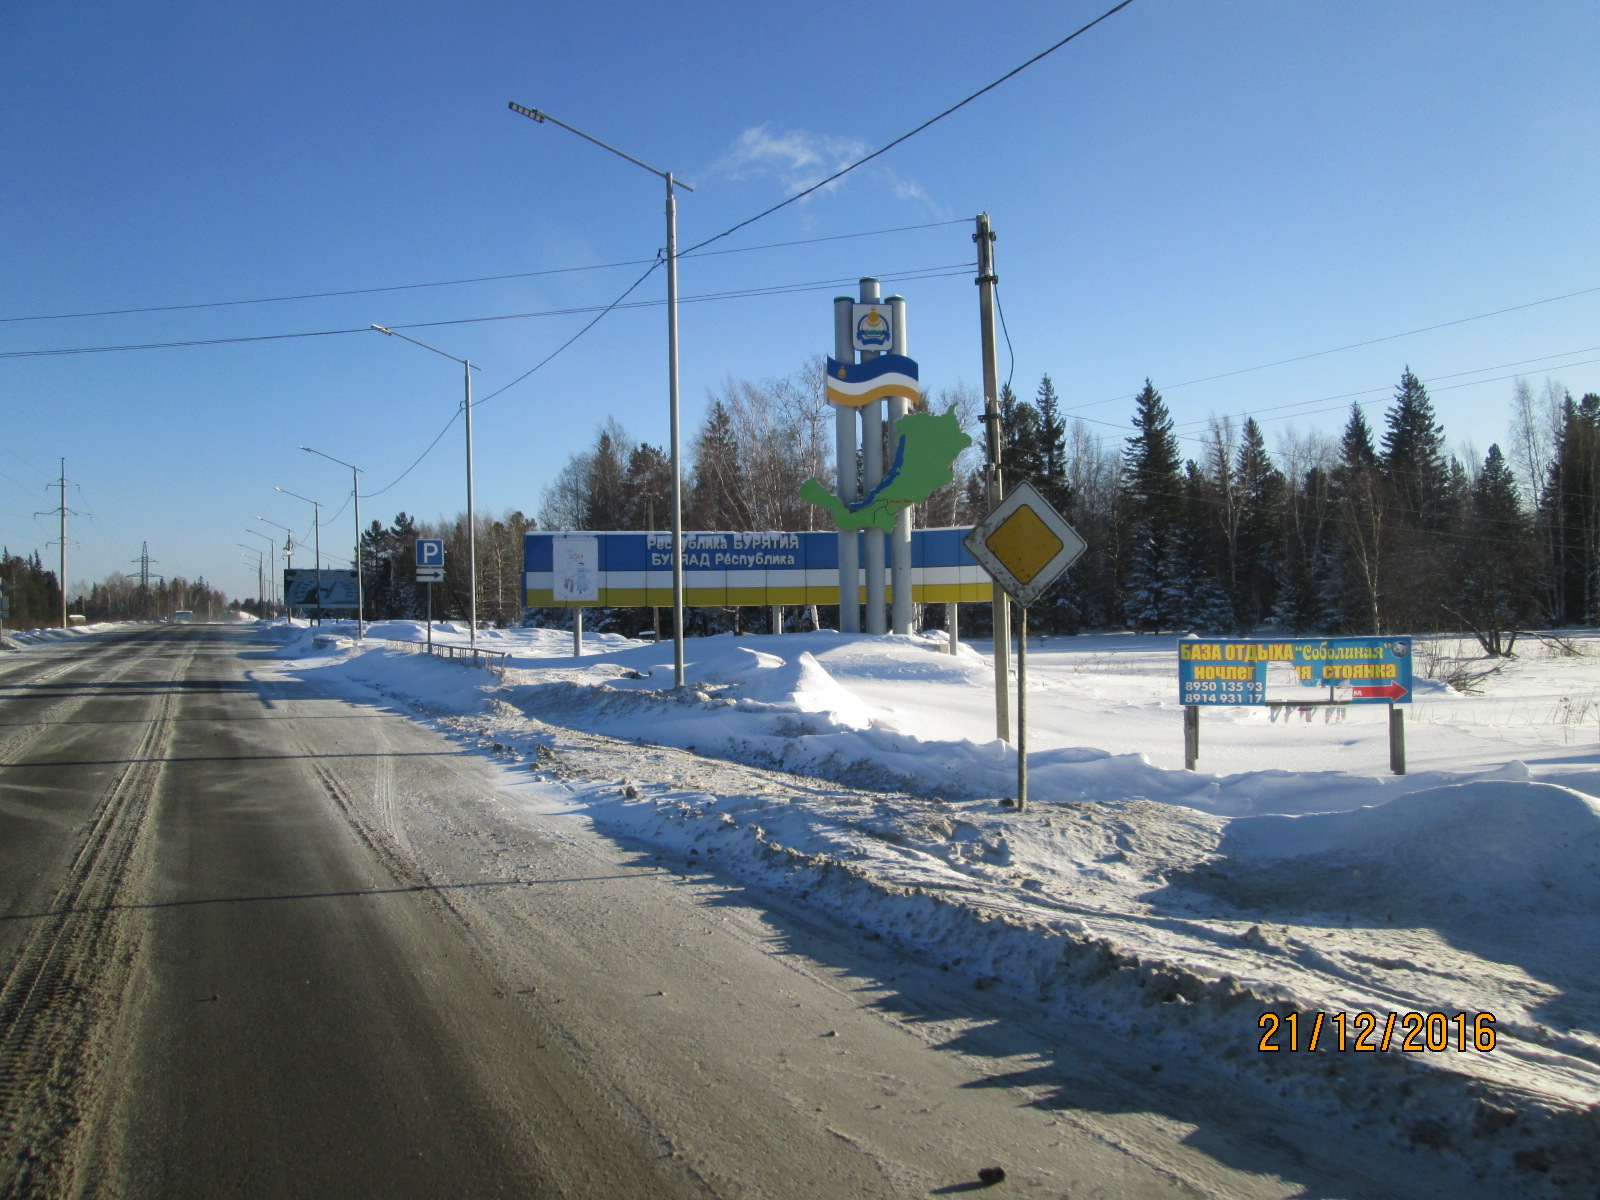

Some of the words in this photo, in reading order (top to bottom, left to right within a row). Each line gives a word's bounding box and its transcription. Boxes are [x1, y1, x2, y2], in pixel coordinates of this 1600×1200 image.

[647, 534, 728, 552] Ресублика
[734, 533, 799, 550] БУРЯТИЯ
[715, 552, 795, 568] Республика
[1181, 644, 1222, 661] БАЗА
[1225, 643, 1295, 663] ОТДЫХА
[1193, 665, 1255, 681] ночлег
[1322, 664, 1397, 679] стоянка
[1185, 682, 1217, 691] 8950
[1221, 682, 1243, 691] 135
[1247, 682, 1262, 691] 93
[1185, 693, 1217, 703] 8914
[1220, 693, 1242, 703] 931
[1248, 693, 1262, 703] 17
